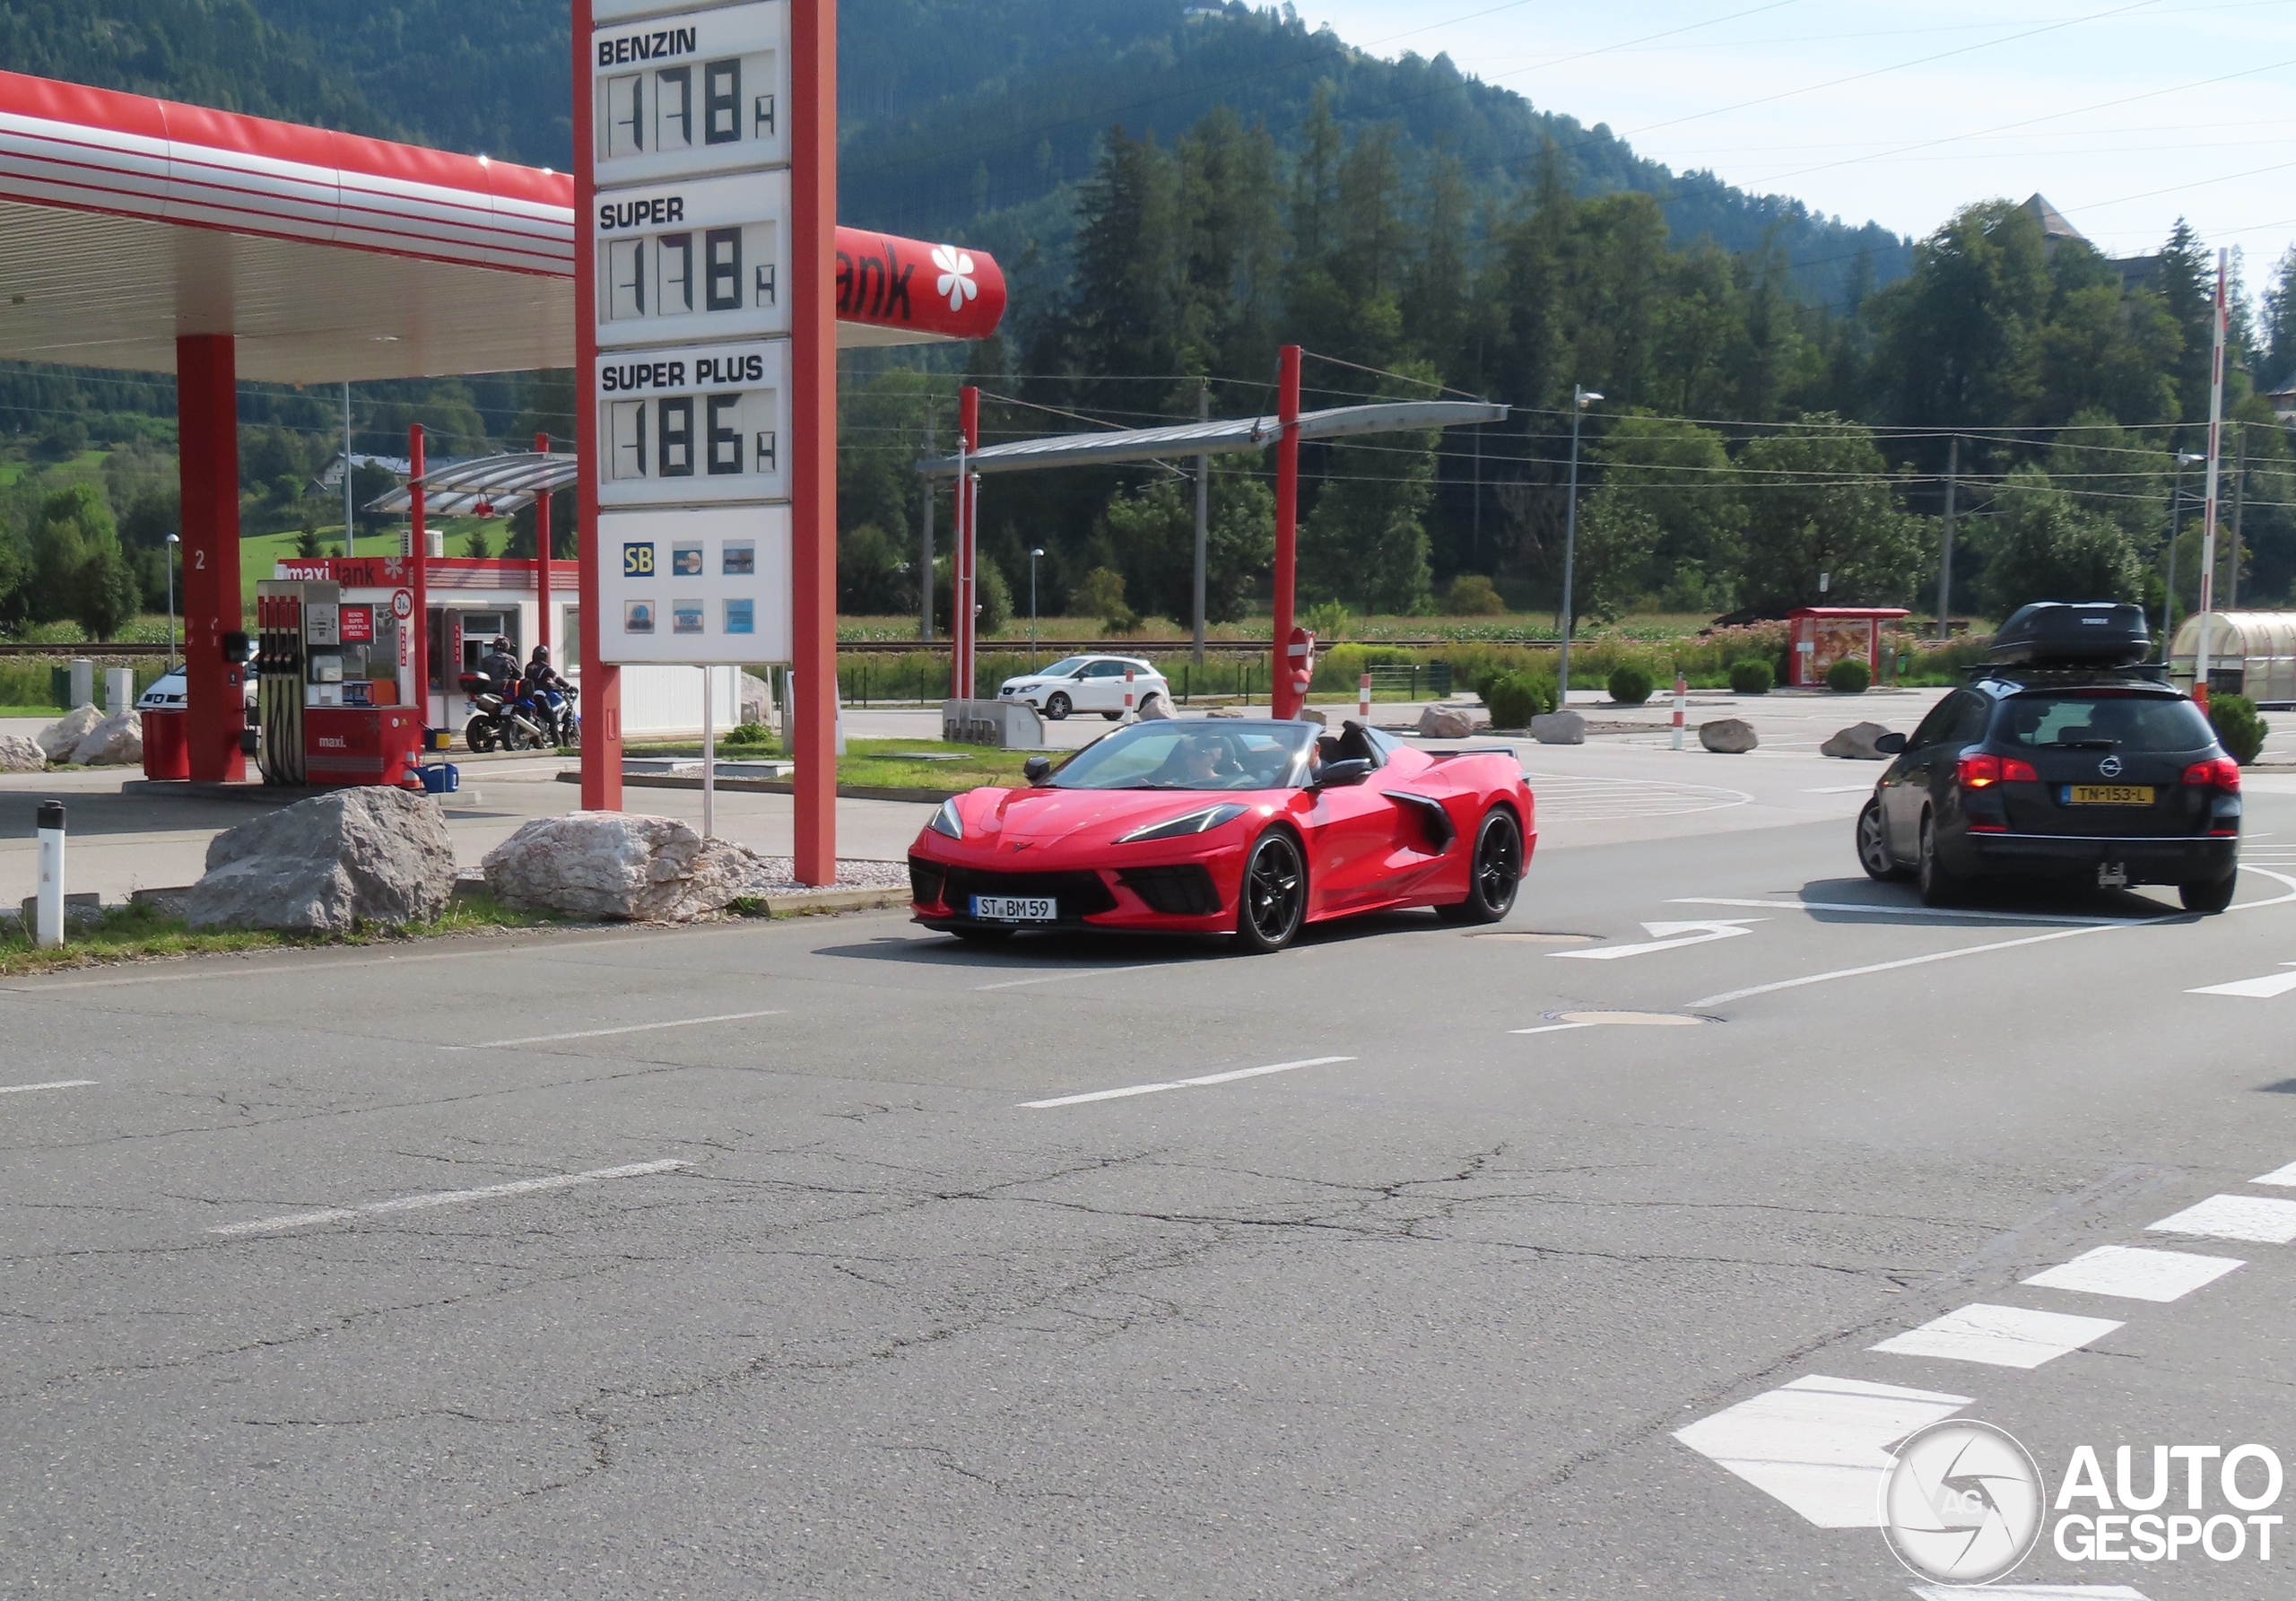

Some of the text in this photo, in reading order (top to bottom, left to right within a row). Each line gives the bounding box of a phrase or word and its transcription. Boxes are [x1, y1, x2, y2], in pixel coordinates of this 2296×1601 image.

[598, 27, 696, 67] BENZIN
[600, 196, 683, 231] SUPER
[602, 355, 763, 391] SUPER PLUS
[195, 550, 205, 570] 2
[625, 546, 653, 573] SB
[336, 561, 375, 586] tank
[2079, 787, 2145, 801] TN-153-L
[981, 899, 997, 915] ST
